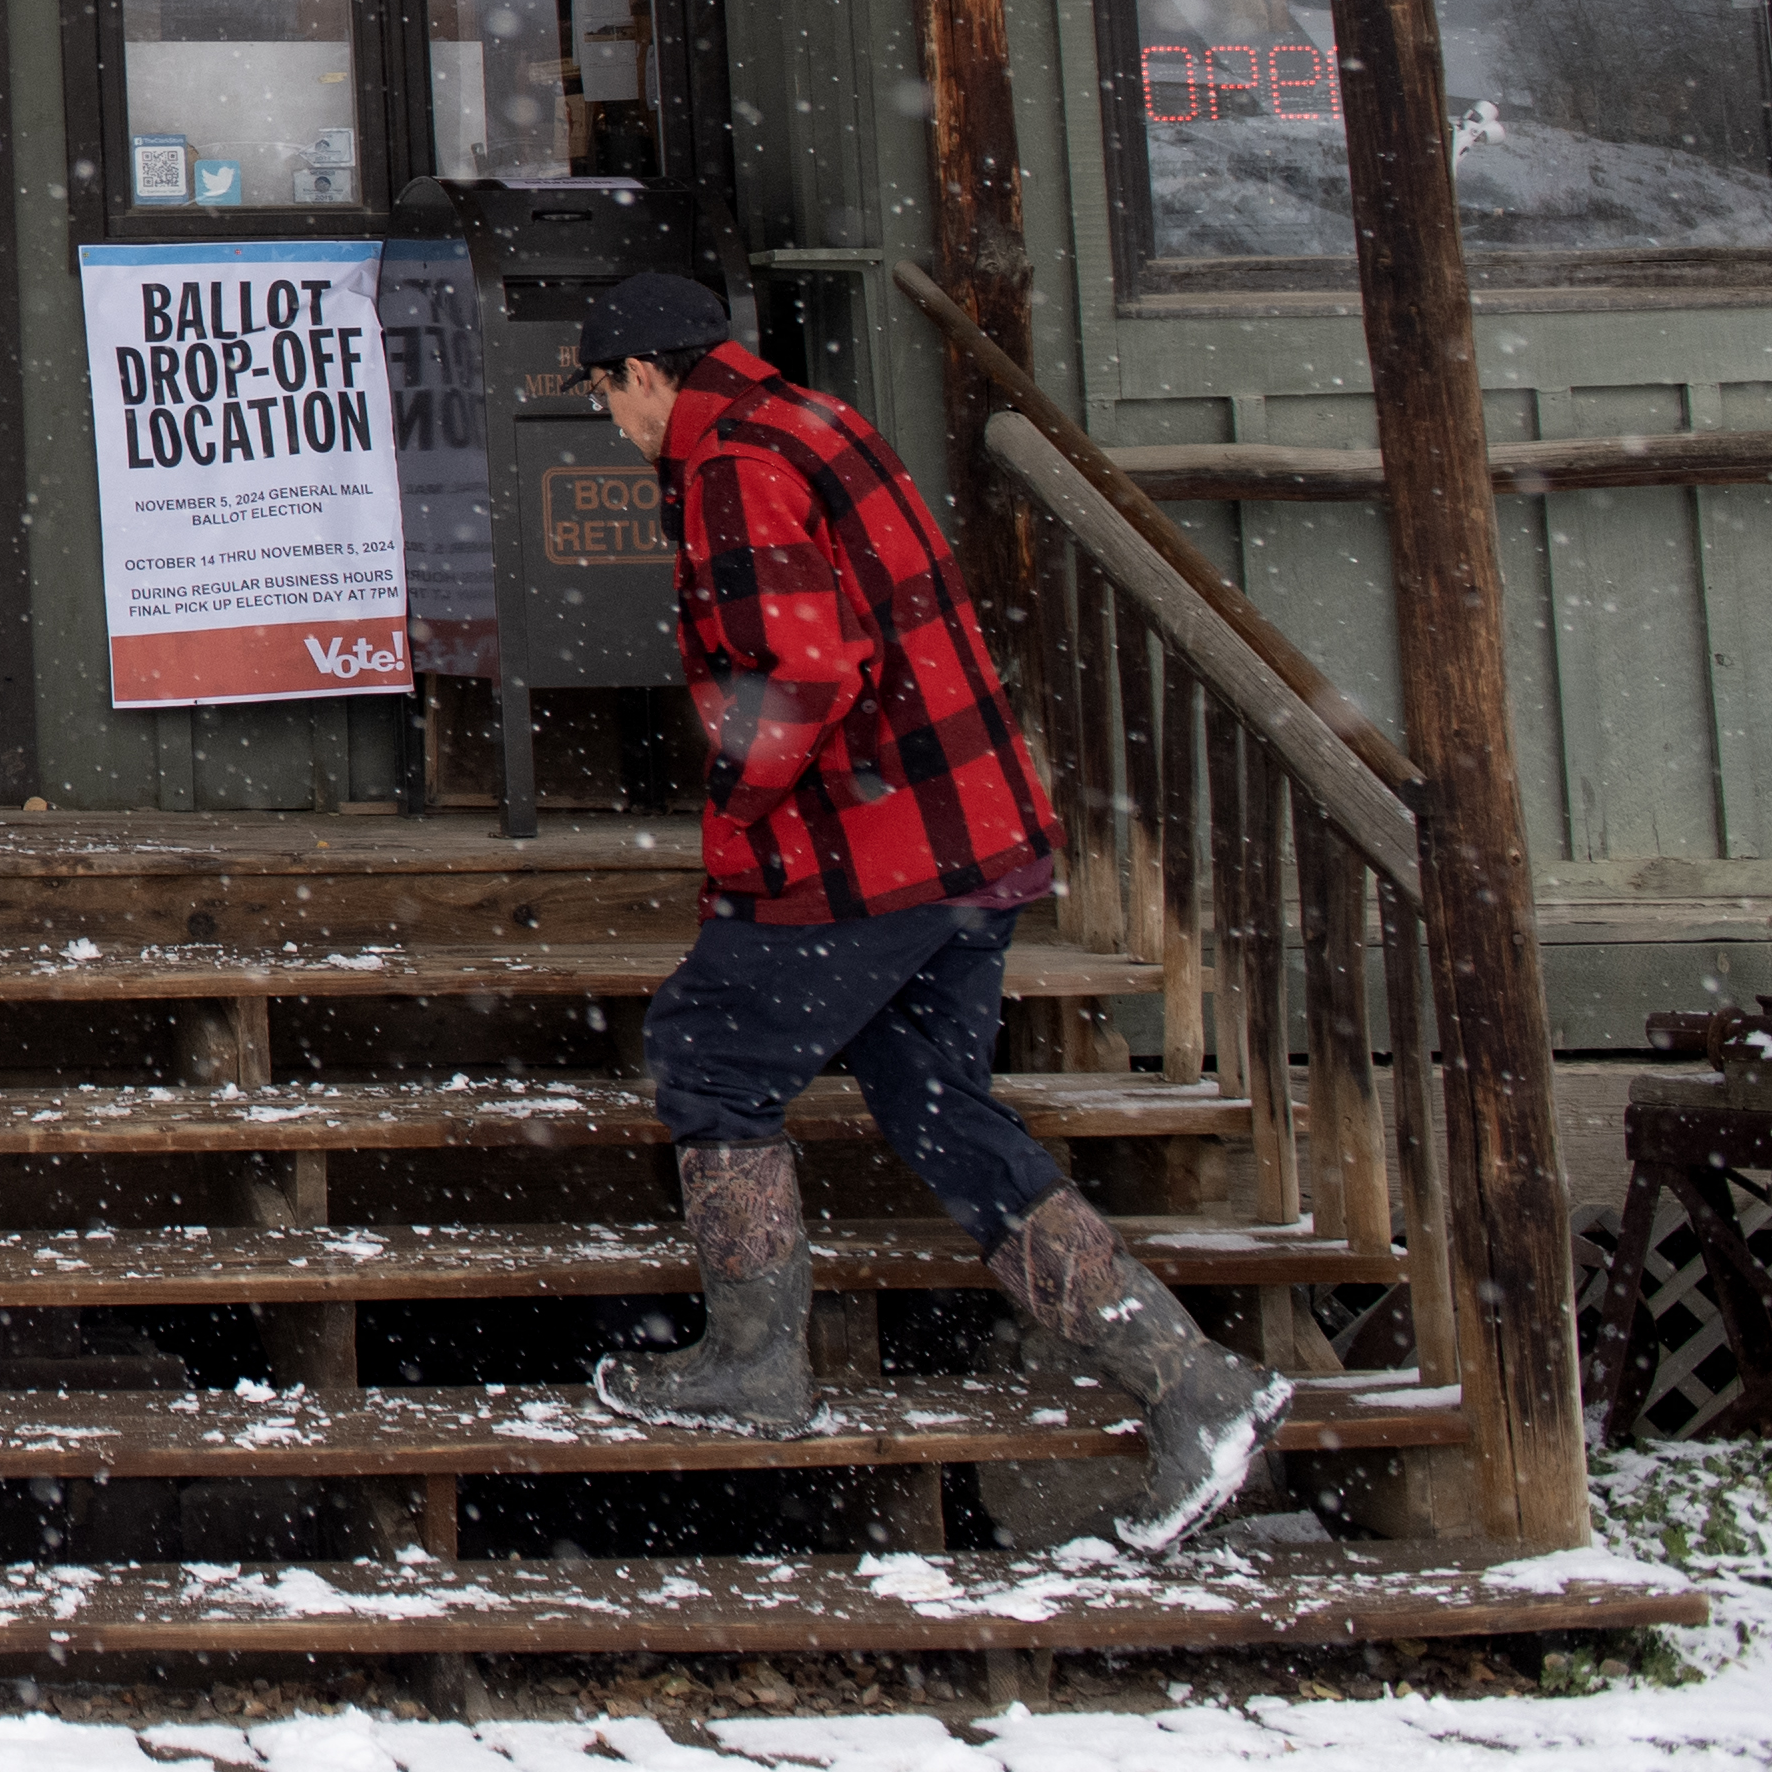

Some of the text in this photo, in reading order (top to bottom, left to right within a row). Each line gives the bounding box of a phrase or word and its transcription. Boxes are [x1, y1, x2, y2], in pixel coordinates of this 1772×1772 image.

[141, 279, 332, 343] BALLOT
[115, 327, 363, 405] DROP-OFF
[124, 390, 372, 469] LOCATION
[134, 483, 374, 513] NOVEMBER 5, 2024 GENERAL MAIL
[574, 479, 661, 511] BOO
[192, 502, 324, 526] BALLOT ELECTION
[556, 520, 668, 552] RETU
[124, 556, 196, 571] OCTOBER
[200, 555, 215, 566] 14
[219, 550, 257, 564] THRU
[260, 543, 344, 560] NOVEMBER
[346, 543, 359, 556] 5,
[362, 540, 395, 554] 2024
[131, 586, 187, 600] DURING
[191, 579, 261, 596] REGULAR
[264, 572, 340, 589] BUSINESS
[343, 569, 394, 584] HOURS
[129, 603, 172, 617] FINAL
[175, 600, 209, 614] PICK
[212, 598, 232, 611] UP
[236, 592, 309, 609] ELECTION
[312, 590, 344, 603] DAY
[347, 588, 367, 601] AT
[370, 586, 399, 599] 7PM
[303, 630, 405, 679] Vote!
